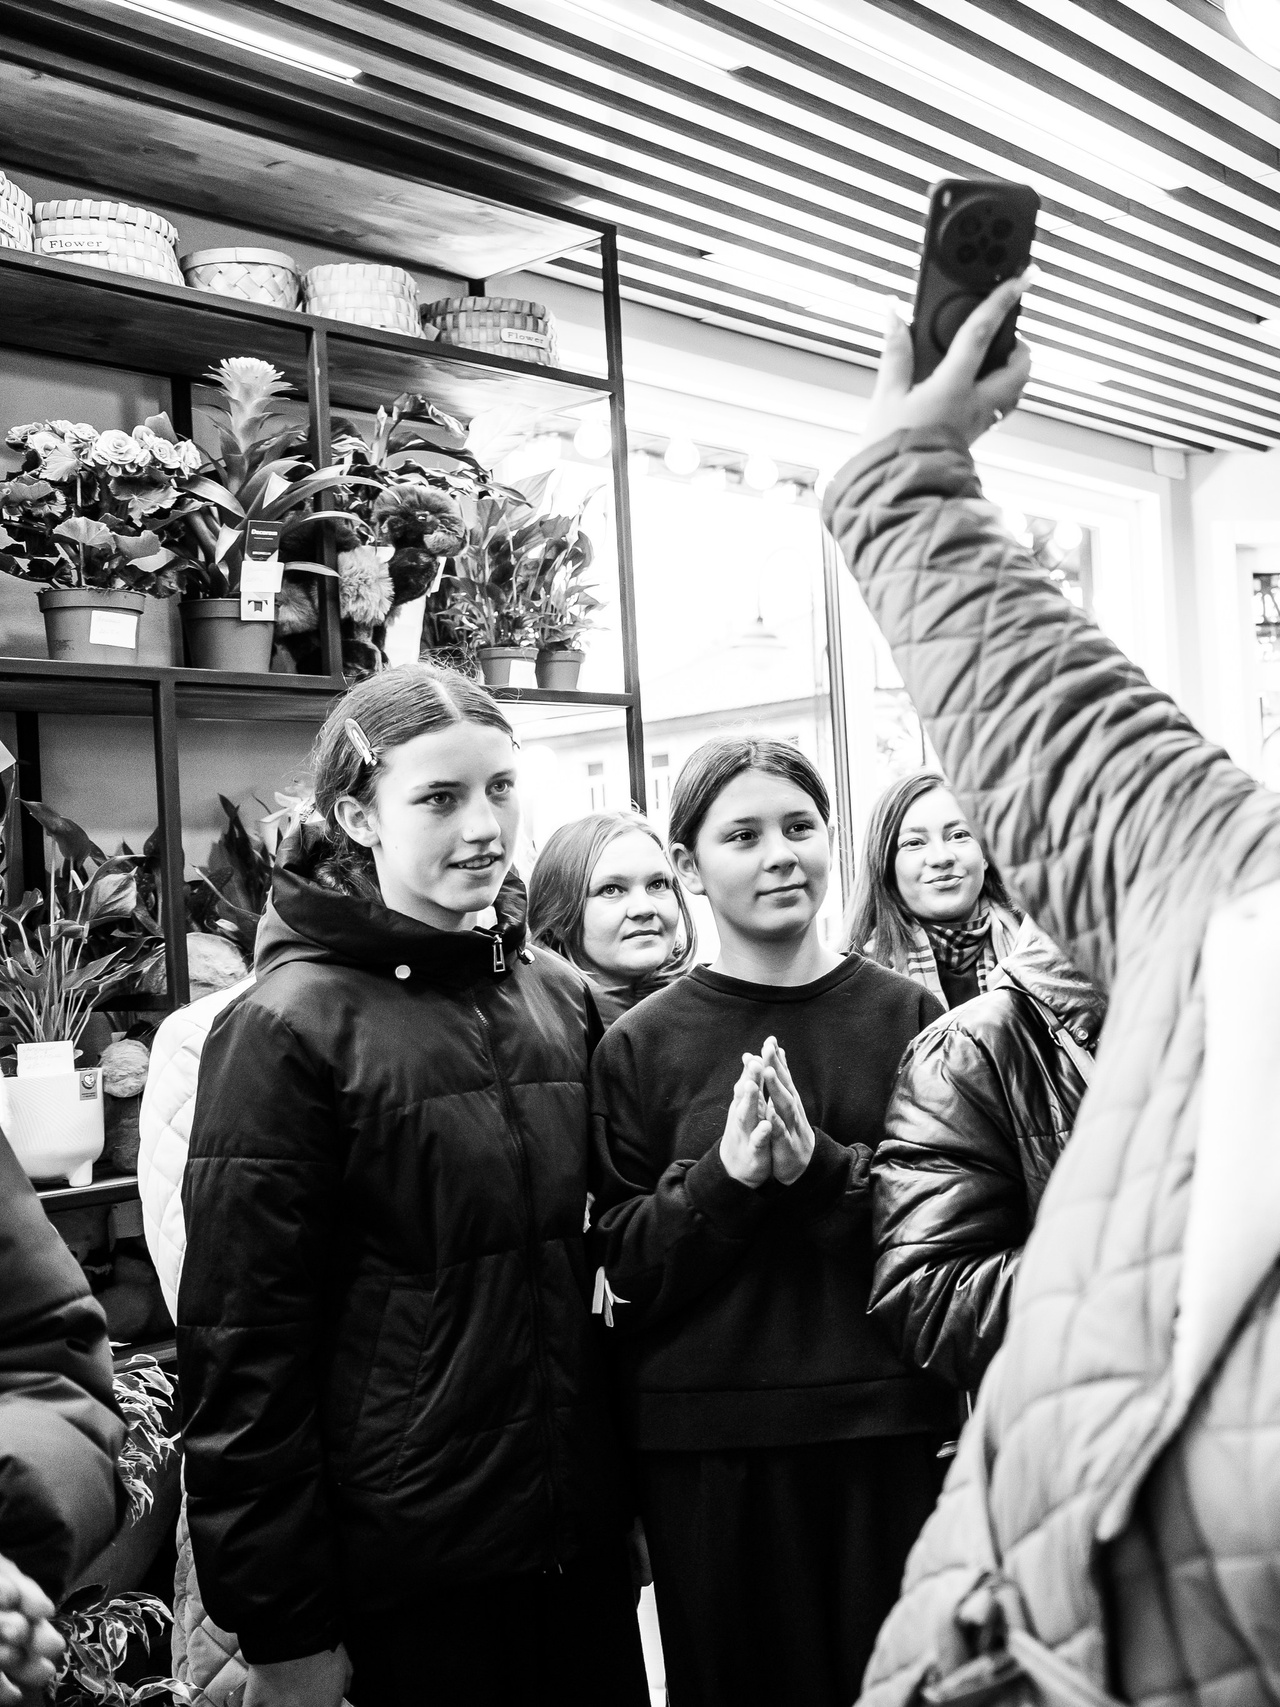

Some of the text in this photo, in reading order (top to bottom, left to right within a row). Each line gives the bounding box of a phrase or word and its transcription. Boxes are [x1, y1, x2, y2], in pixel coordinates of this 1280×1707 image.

[0, 218, 15, 232] wer
[49, 239, 102, 249] Flower
[507, 331, 544, 344] Flower
